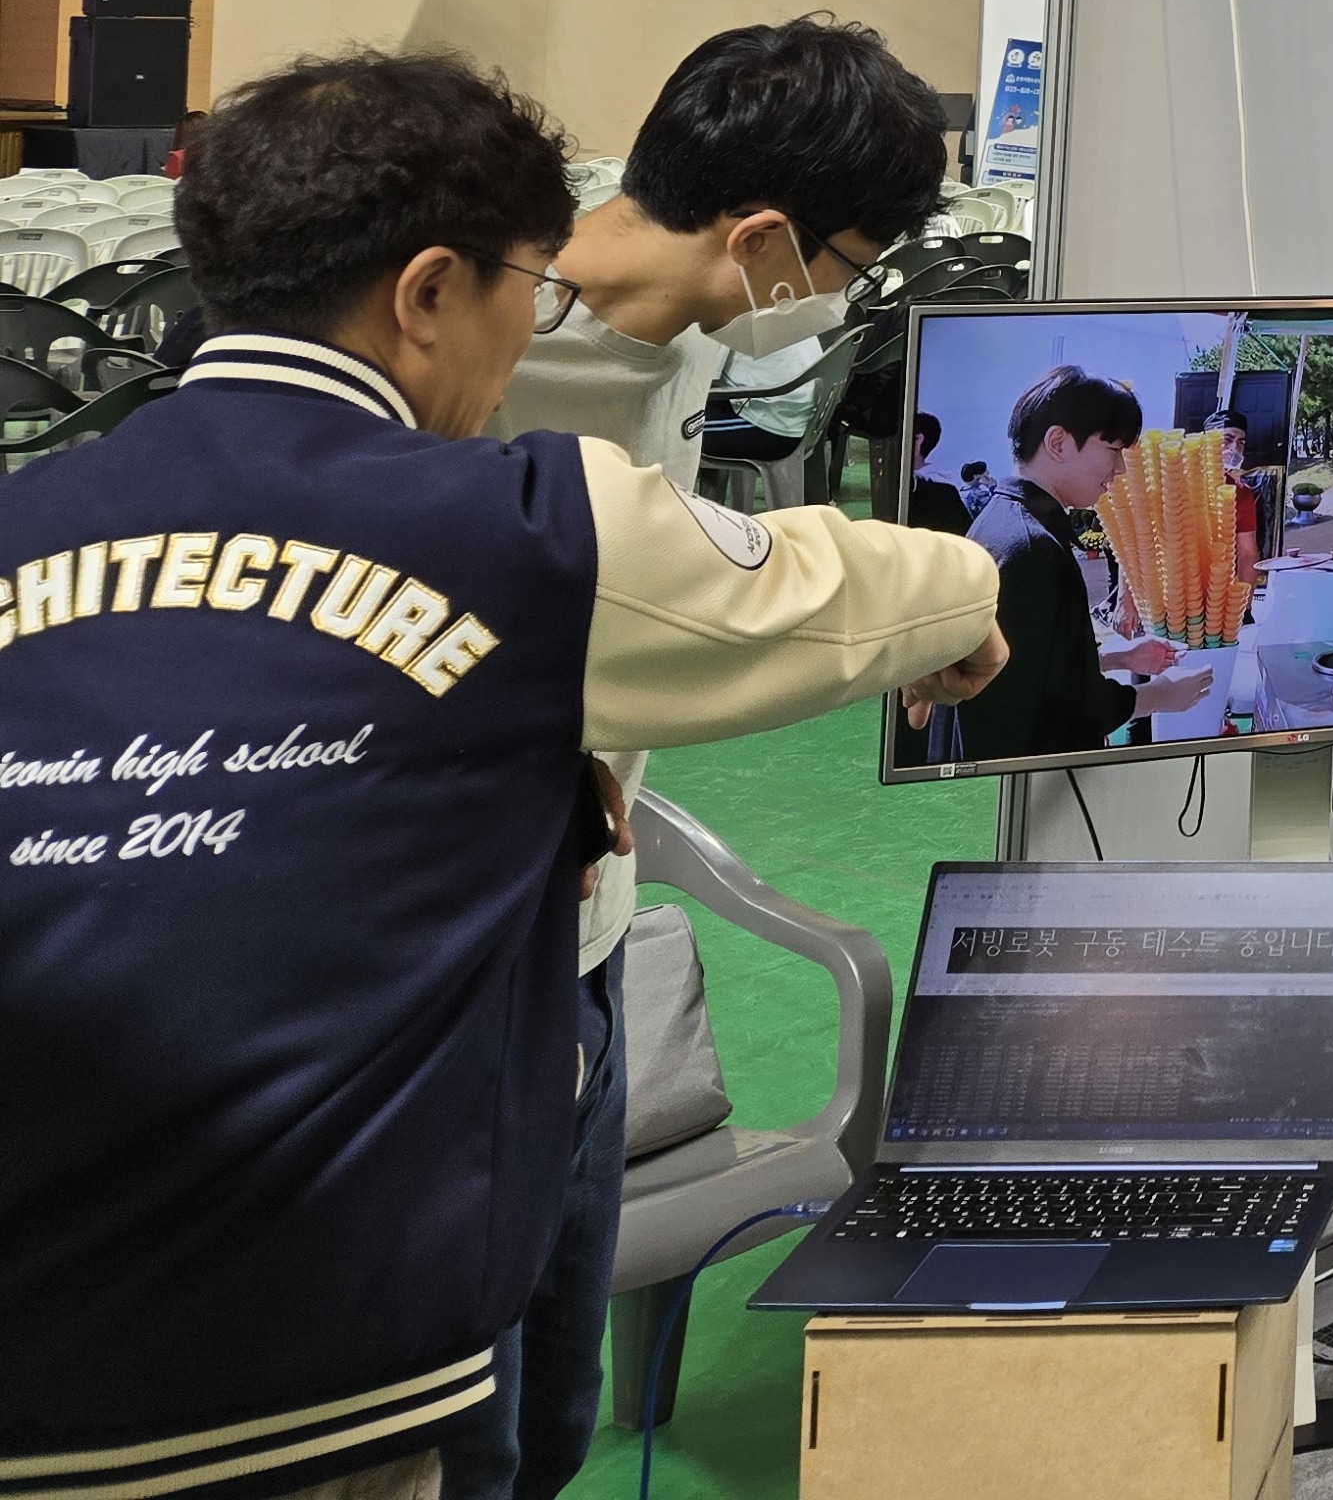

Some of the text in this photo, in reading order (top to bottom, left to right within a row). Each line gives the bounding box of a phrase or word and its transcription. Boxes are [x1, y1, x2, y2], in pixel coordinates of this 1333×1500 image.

[111, 728, 216, 797] high
[223, 722, 375, 774] school
[9, 808, 247, 867] since 2014
[952, 928, 1060, 959] 서빙로봇
[1072, 929, 1127, 959] 구동
[1141, 928, 1221, 959] 테스트
